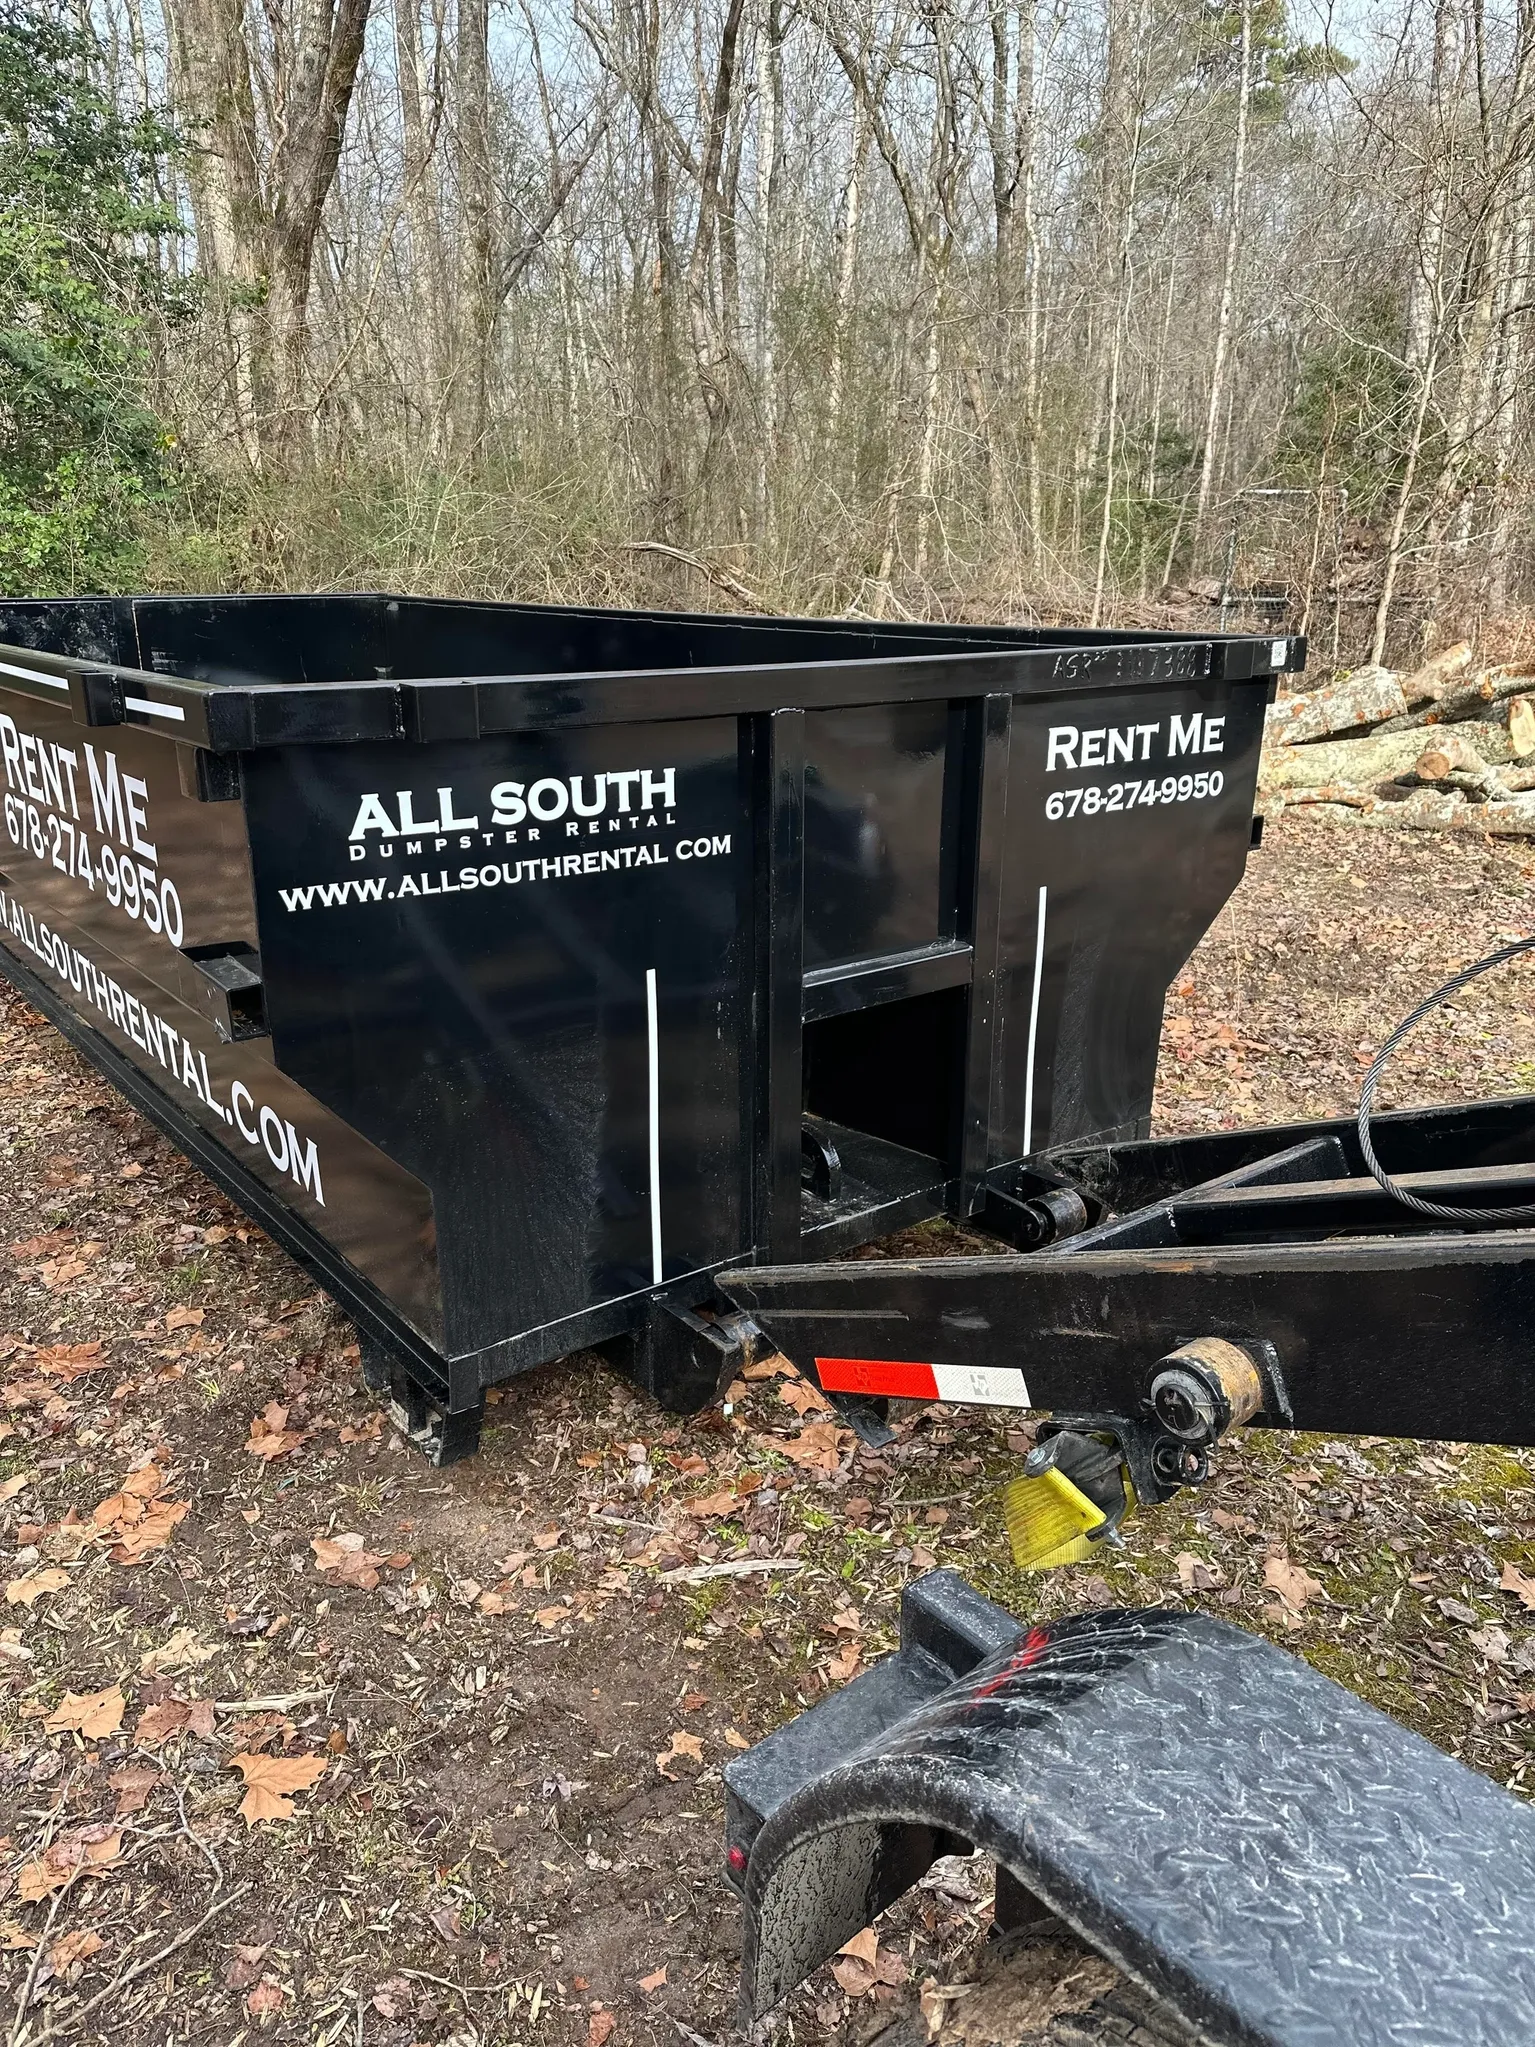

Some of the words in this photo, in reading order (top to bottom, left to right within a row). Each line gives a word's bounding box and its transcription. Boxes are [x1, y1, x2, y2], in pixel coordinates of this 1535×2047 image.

[1045, 721, 1160, 772] RENT
[1167, 712, 1226, 757] ME
[0, 713, 81, 821] RENT
[83, 742, 158, 867] ME
[348, 787, 479, 841] ALL
[490, 767, 677, 826] SOUTH
[1045, 770, 1224, 821] 678-274-9950
[4, 792, 184, 948] 678-274-9950
[348, 829, 541, 861] DUMPSTER
[566, 813, 677, 837] RENTAL
